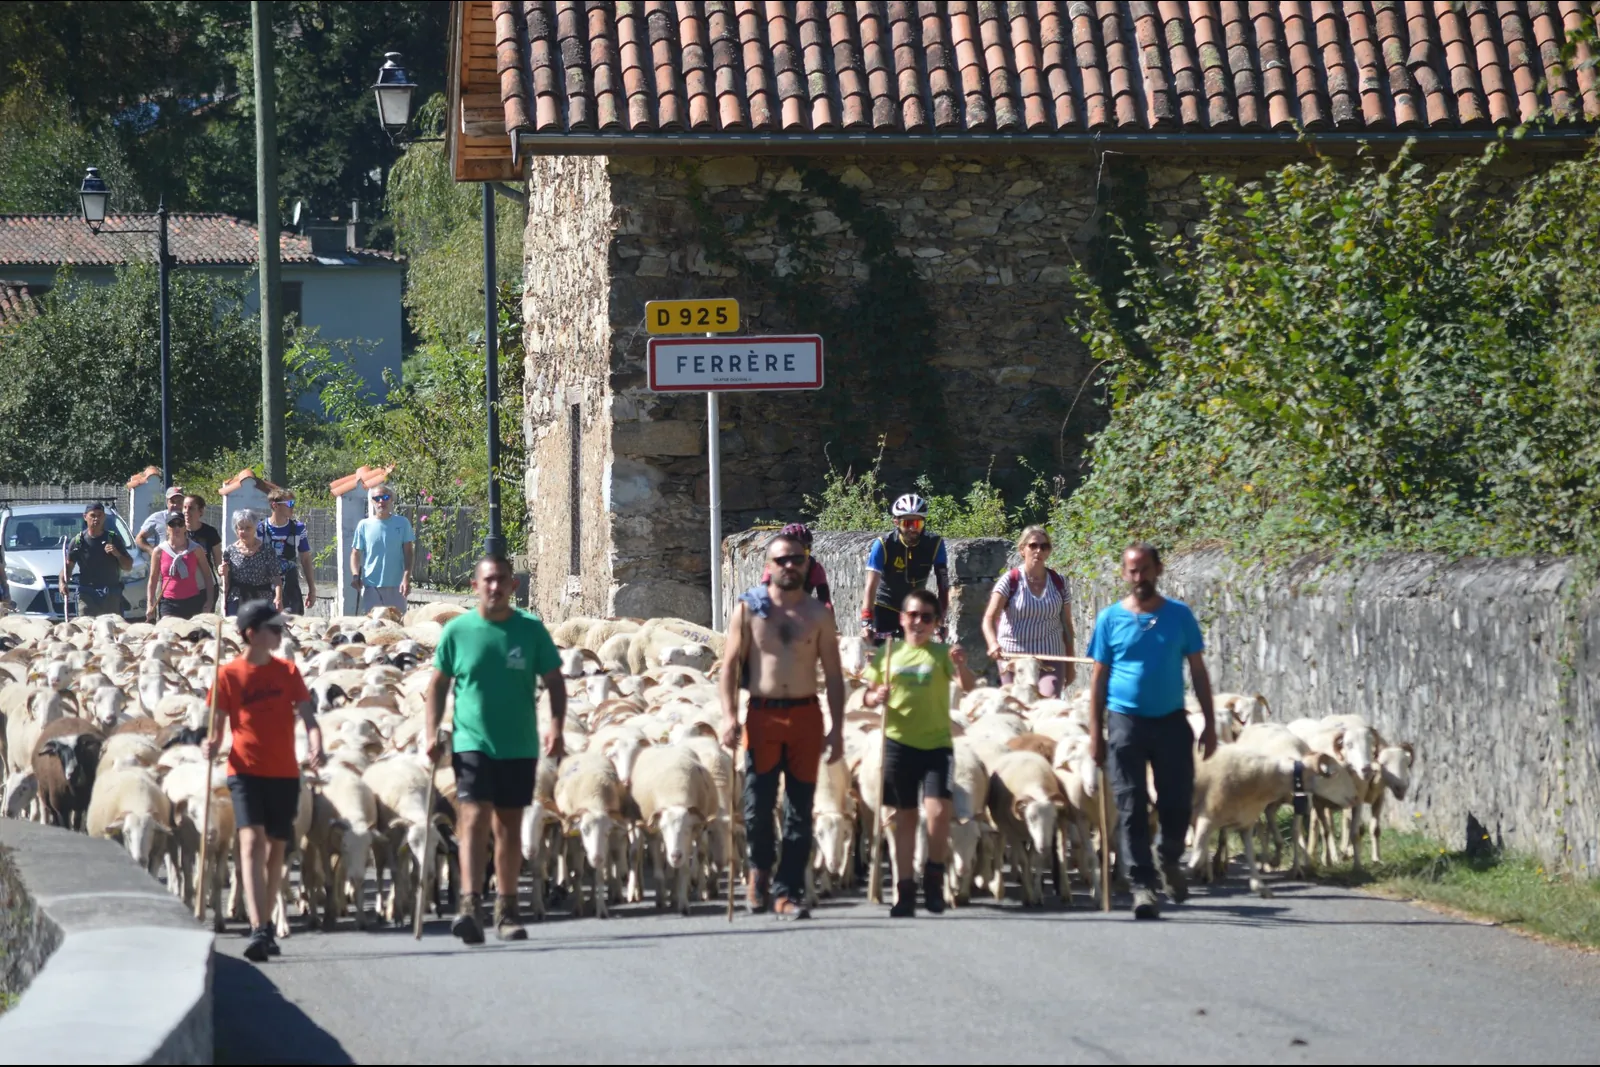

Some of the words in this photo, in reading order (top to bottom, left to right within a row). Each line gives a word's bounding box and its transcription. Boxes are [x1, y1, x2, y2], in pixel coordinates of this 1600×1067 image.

[657, 308, 670, 327] D
[679, 306, 728, 326] 925
[676, 349, 796, 374] FERRÈRE
